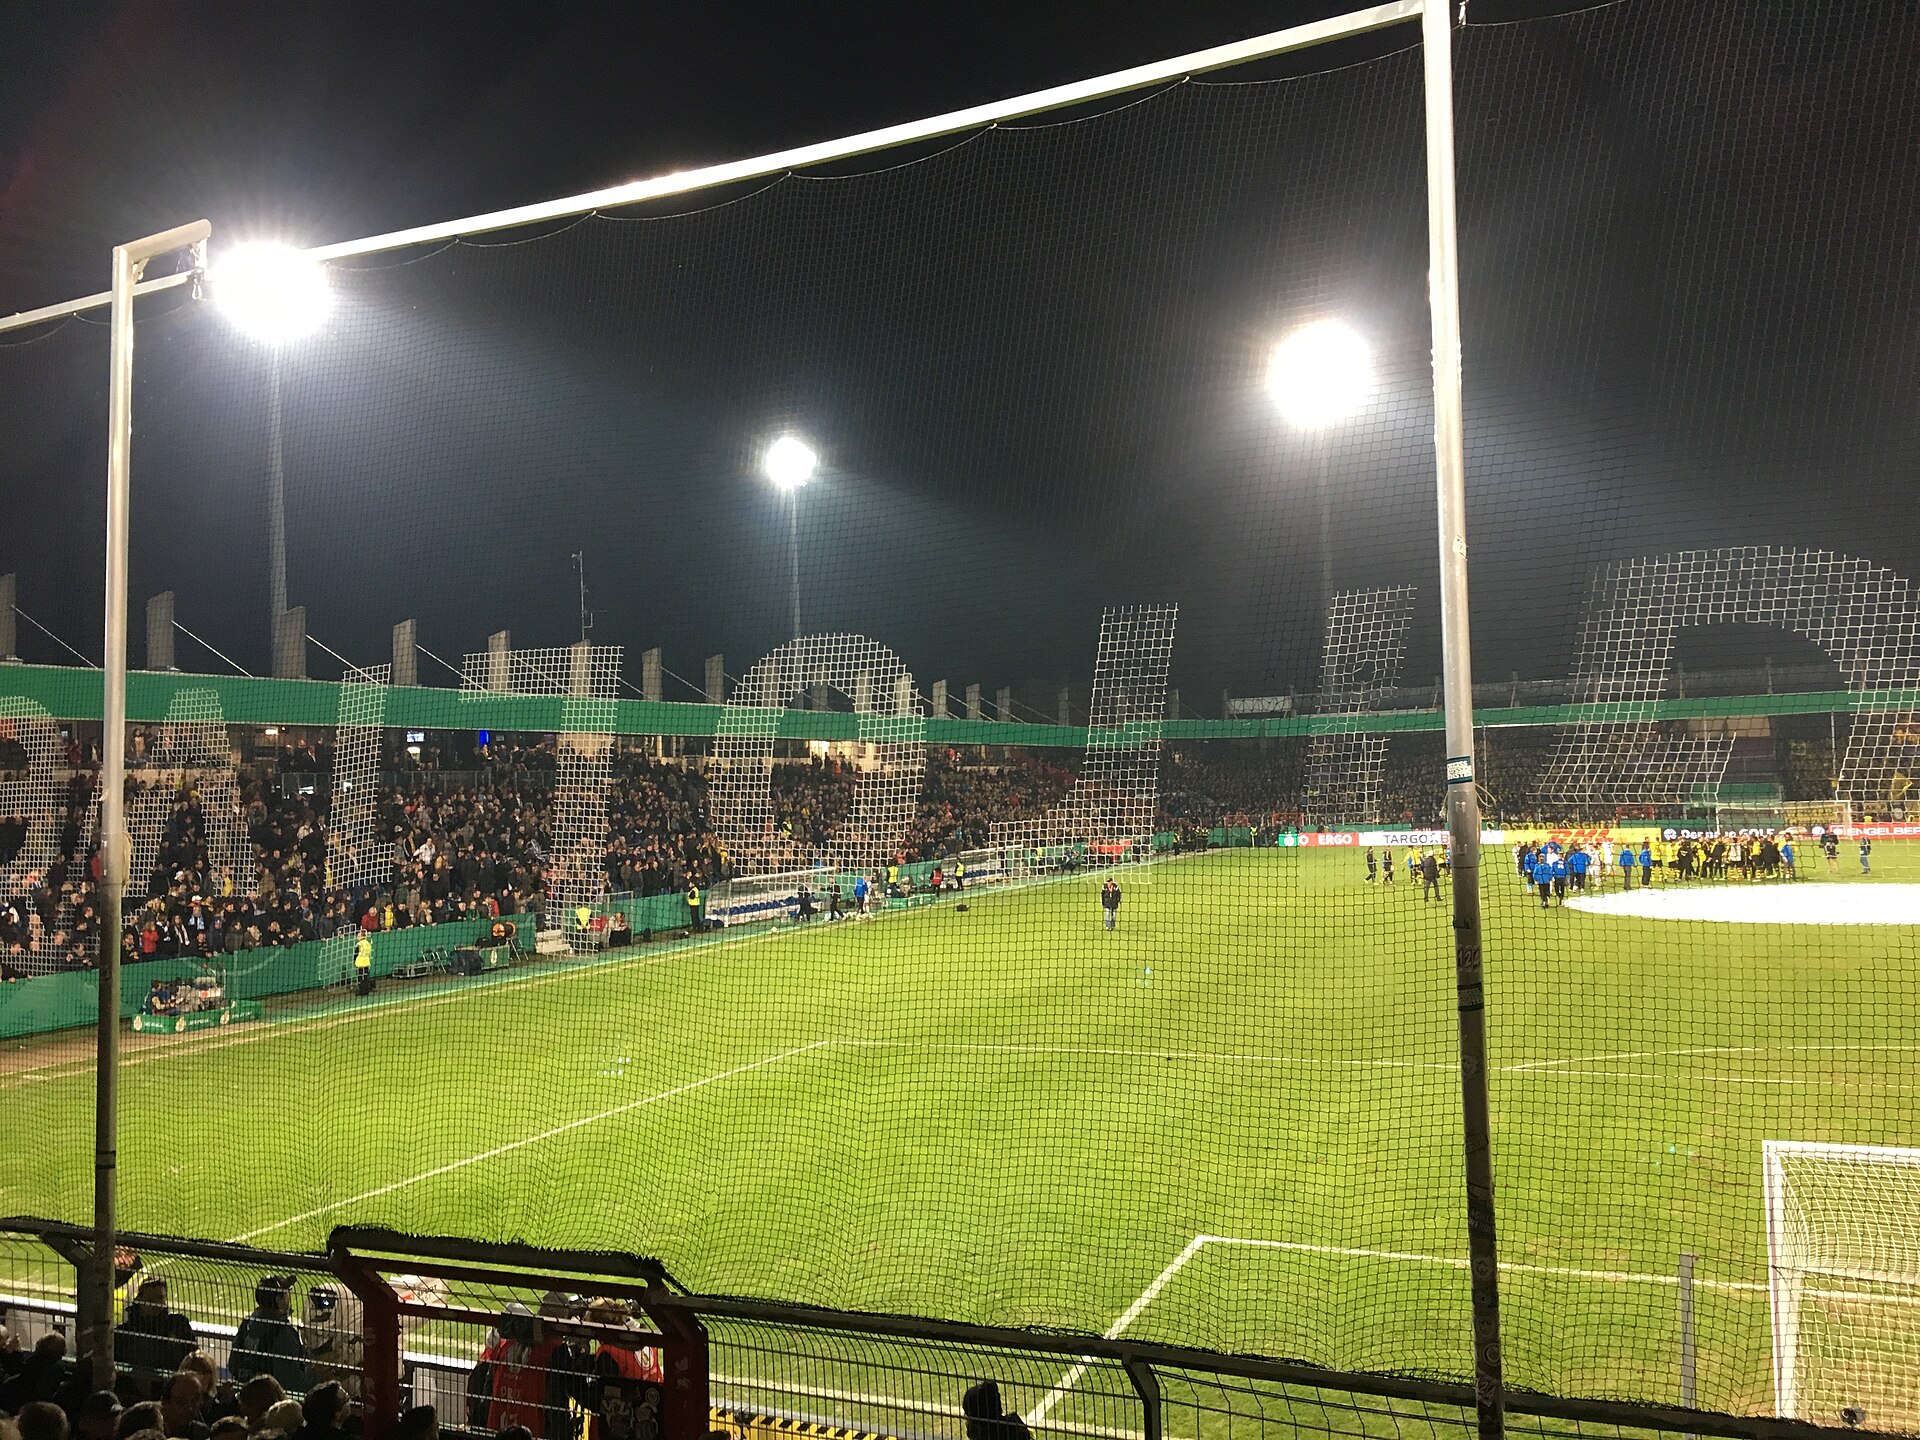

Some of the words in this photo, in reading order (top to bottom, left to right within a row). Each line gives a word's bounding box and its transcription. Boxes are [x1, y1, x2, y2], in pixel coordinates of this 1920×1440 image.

[1318, 833, 1352, 845] ERGO
[1547, 829, 1614, 843] DHL
[1738, 828, 1775, 839] GOLF
